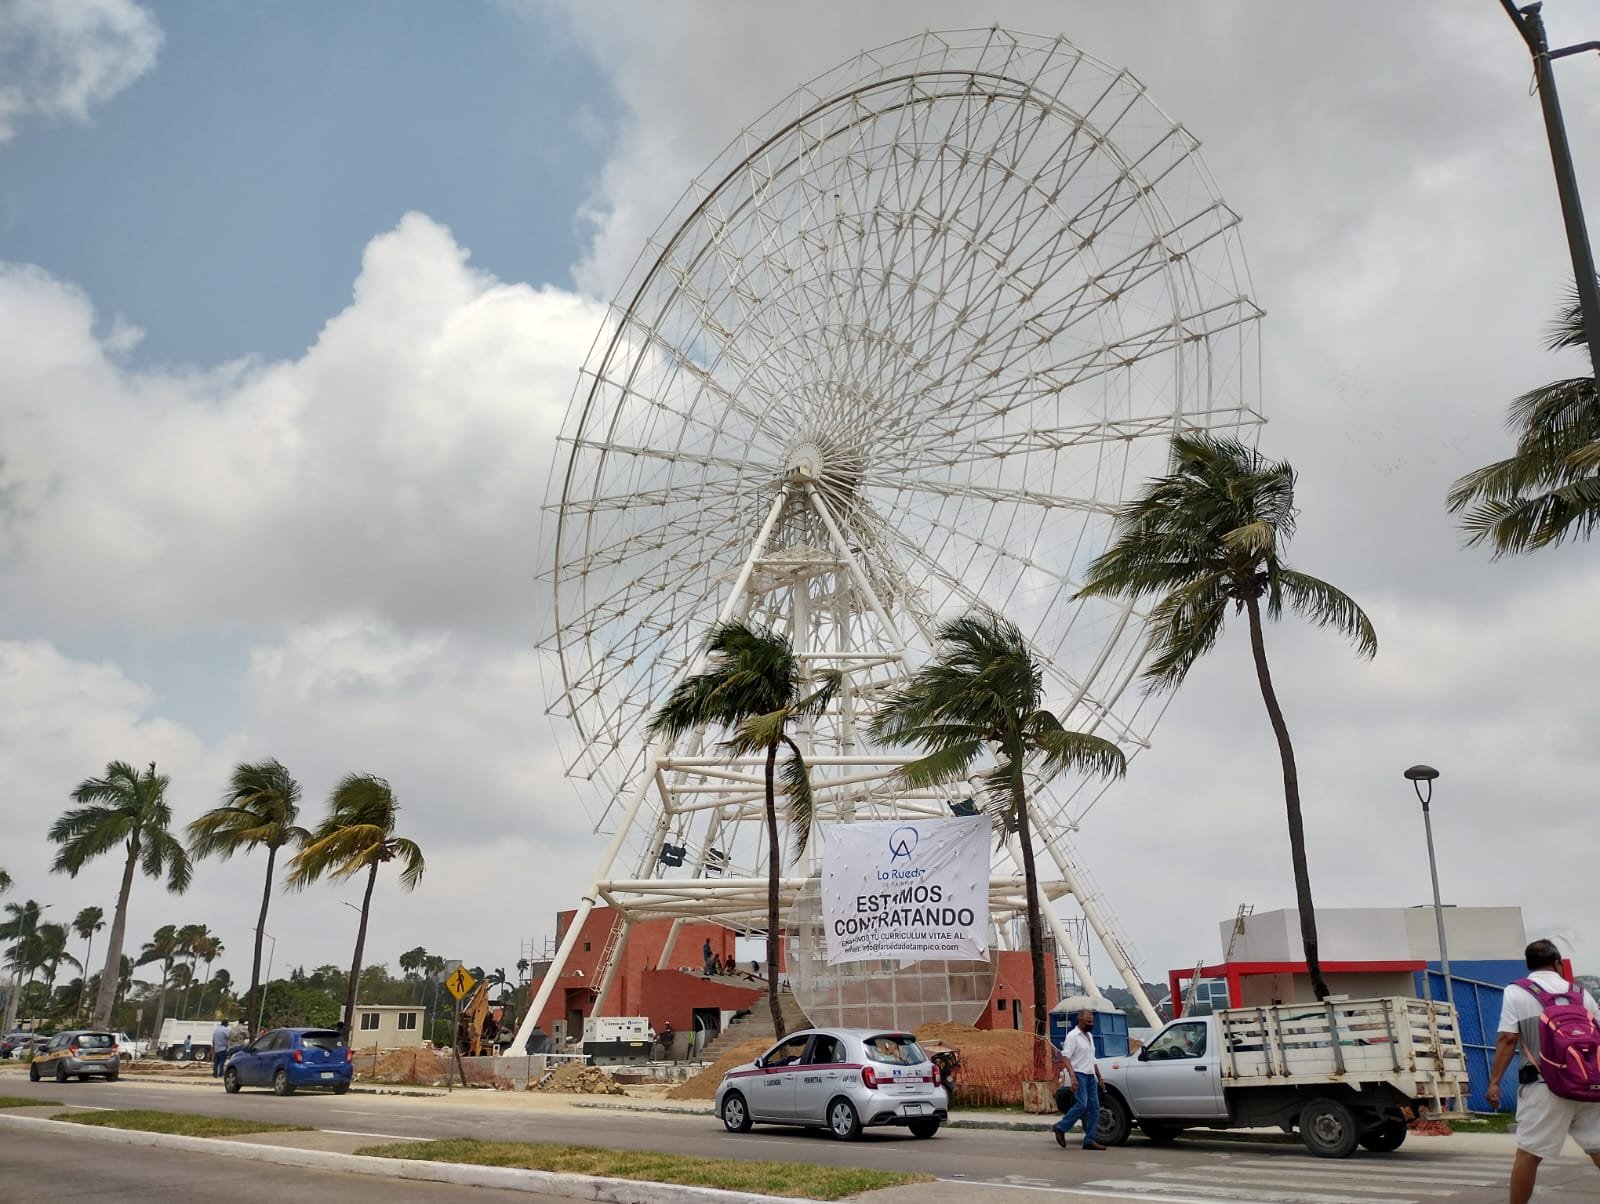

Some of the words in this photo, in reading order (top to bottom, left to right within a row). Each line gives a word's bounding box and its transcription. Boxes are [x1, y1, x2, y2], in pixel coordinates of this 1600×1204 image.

[877, 869, 889, 880] La
[834, 908, 975, 936] CONTRATANDO
[871, 933, 879, 941] TU
[928, 932, 952, 940] VITAE
